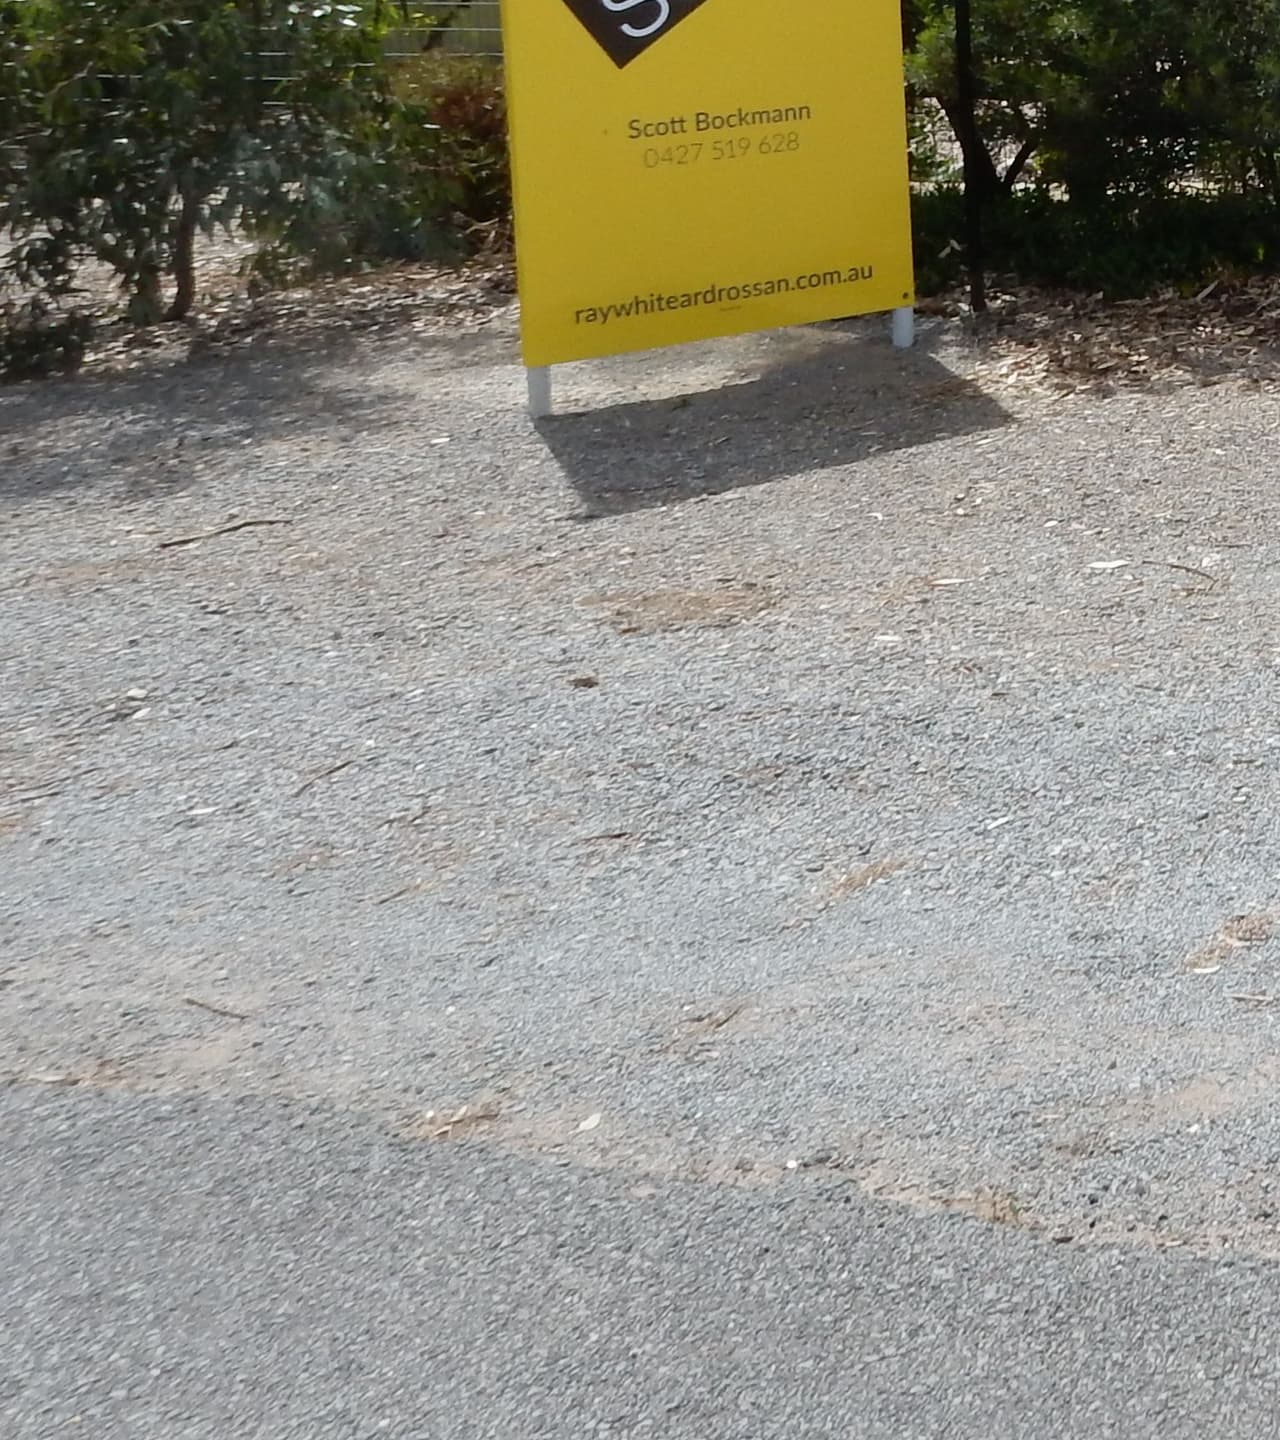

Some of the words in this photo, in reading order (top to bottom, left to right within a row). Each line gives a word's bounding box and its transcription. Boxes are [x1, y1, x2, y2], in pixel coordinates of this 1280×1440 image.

[627, 116, 688, 140] Scott
[695, 104, 812, 132] Bockmann
[642, 142, 704, 169] 0427
[711, 136, 751, 161] 519
[758, 130, 800, 155] 628
[574, 264, 874, 325] raywhiteardrossan.com.au
